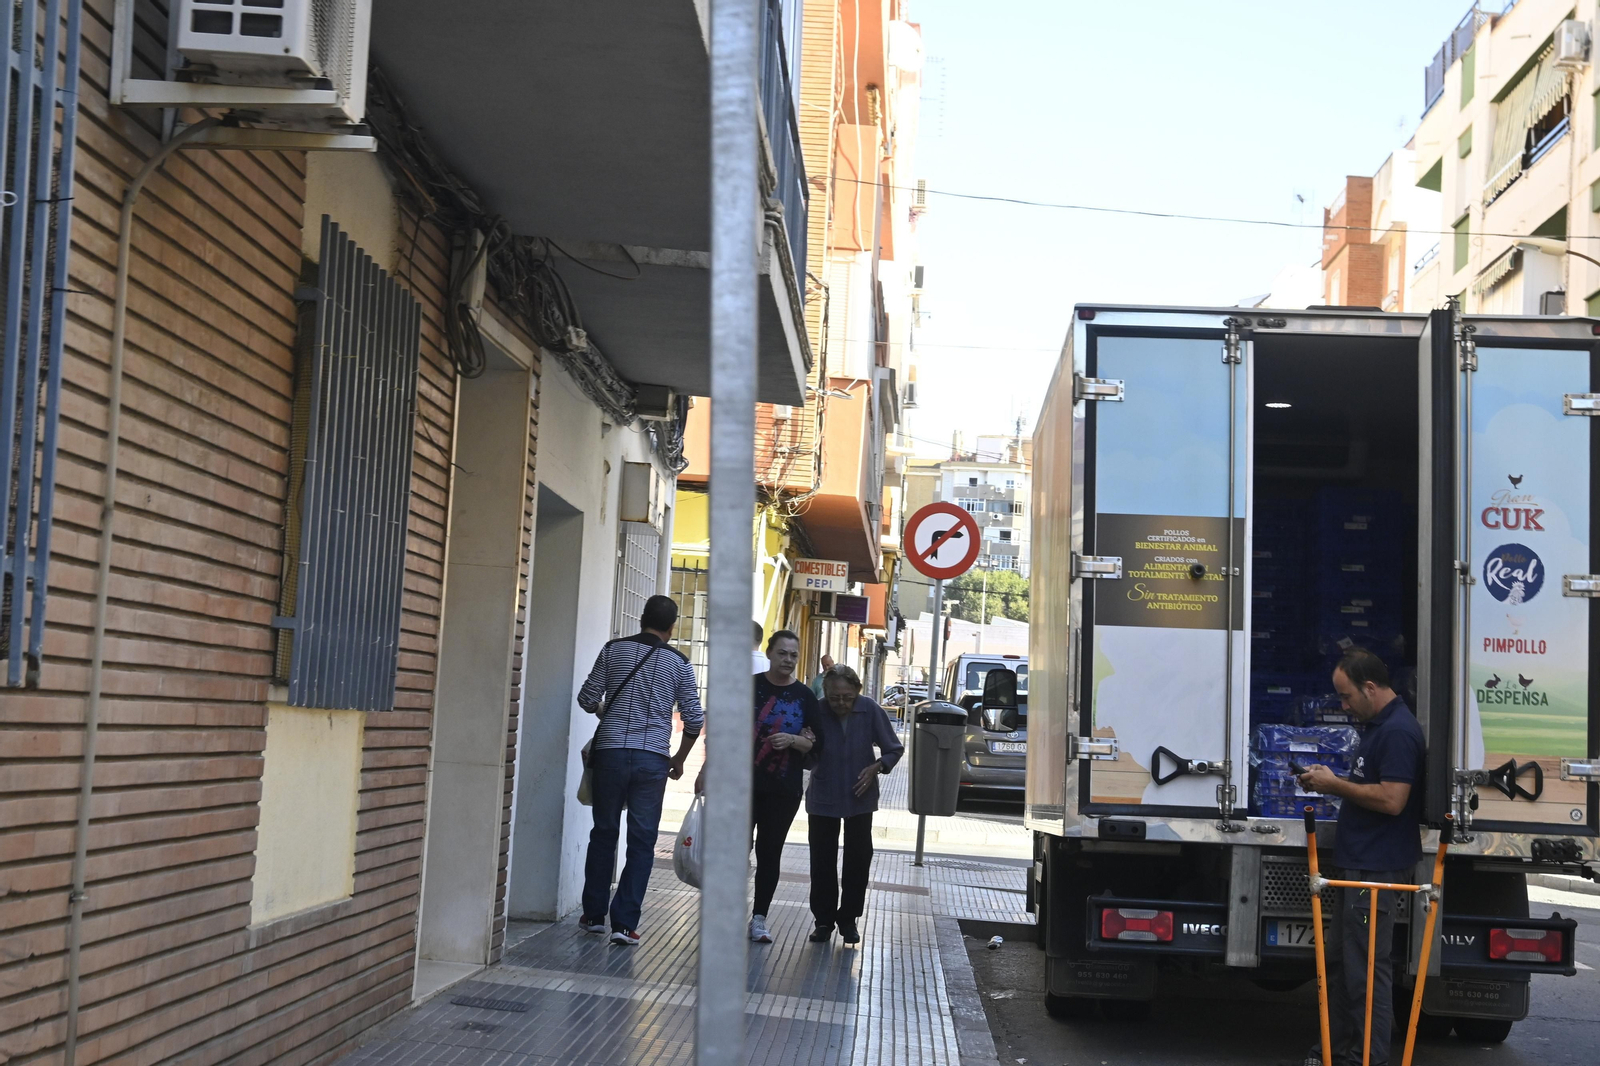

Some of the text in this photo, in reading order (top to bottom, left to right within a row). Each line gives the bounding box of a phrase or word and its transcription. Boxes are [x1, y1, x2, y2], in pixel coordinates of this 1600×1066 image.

[1481, 507, 1545, 531] CUK
[1147, 535, 1196, 543] CERTIFICADOS
[1135, 542, 1218, 552] BIENESTAR ANIMAL
[794, 561, 847, 577] COMESTIBLES
[1128, 570, 1185, 580] TOTALMENTE
[1486, 557, 1538, 590] Real
[806, 578, 833, 589] PEPI
[1127, 583, 1218, 603] Sin TRATAMIENTO
[1146, 600, 1203, 611] ANTIBIÓTICO
[1483, 637, 1547, 655] PIMPOLLO
[1477, 689, 1549, 706] DESPENSA
[1448, 989, 1464, 997] 955
[1484, 992, 1500, 1000] 460
